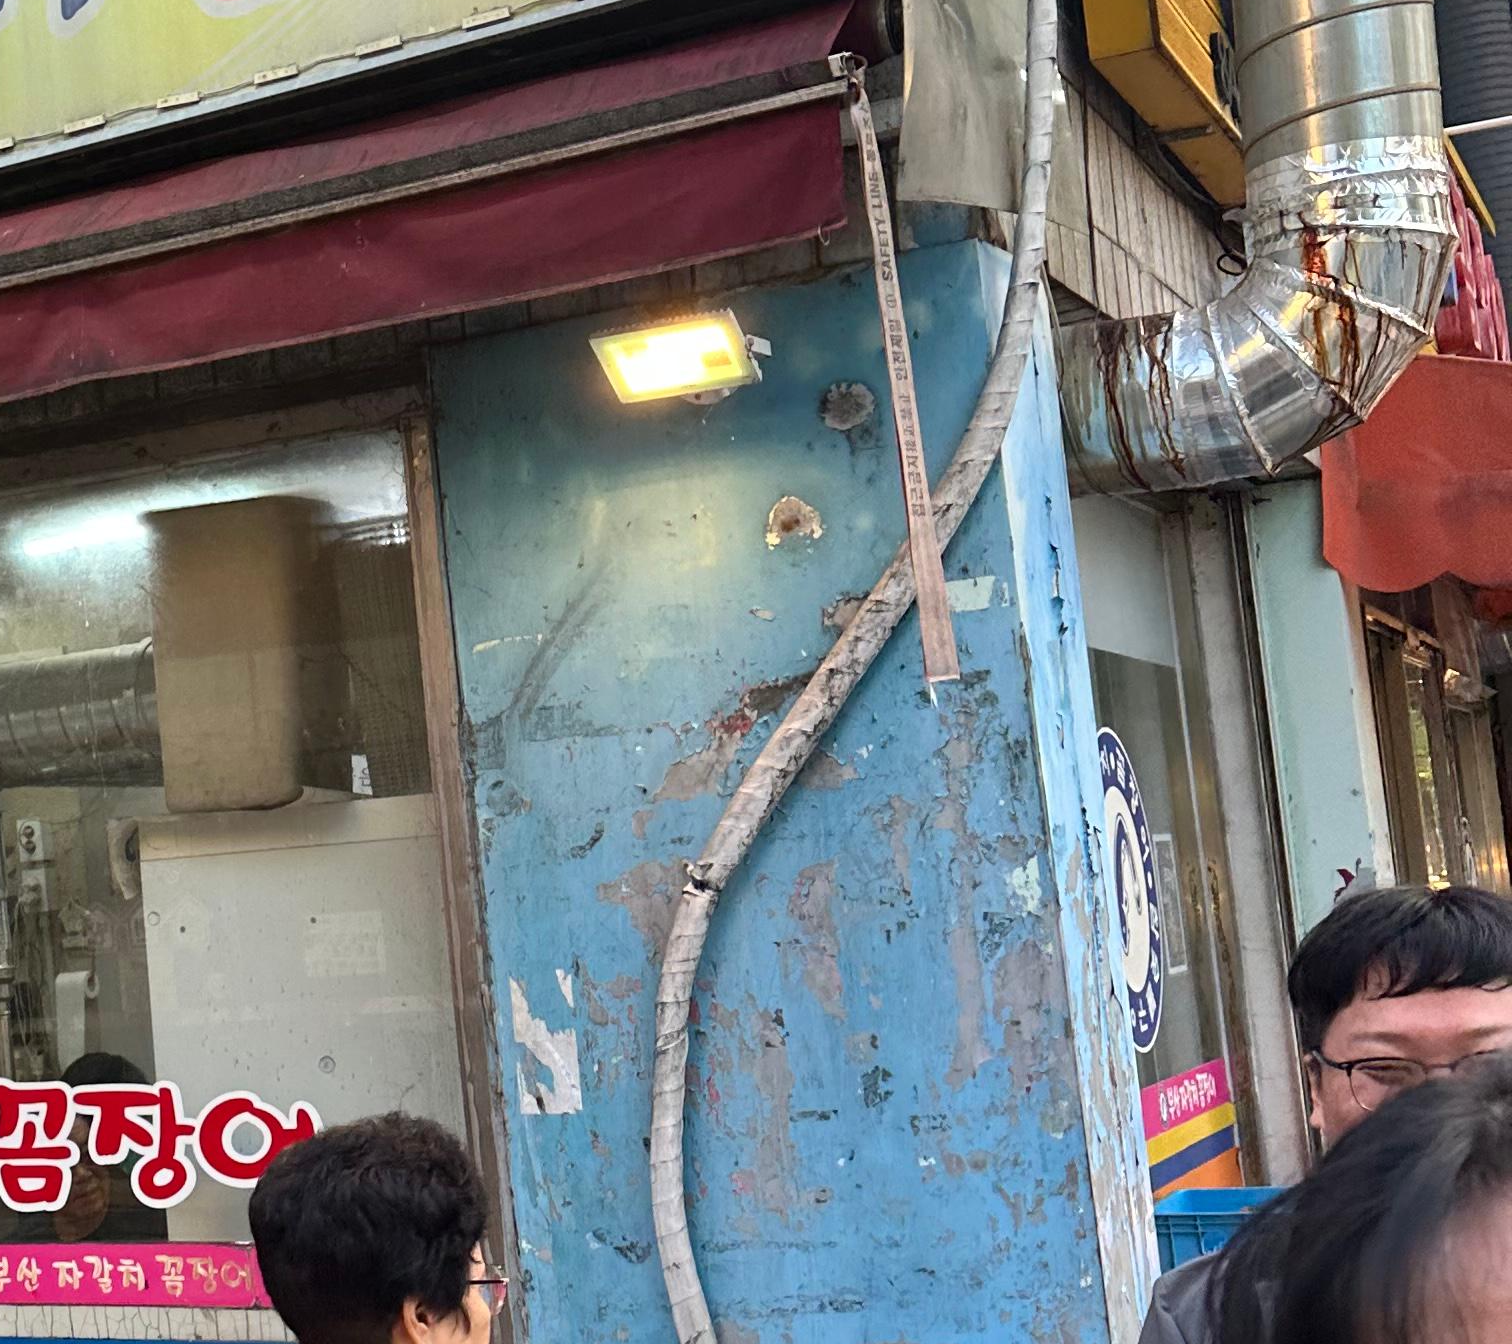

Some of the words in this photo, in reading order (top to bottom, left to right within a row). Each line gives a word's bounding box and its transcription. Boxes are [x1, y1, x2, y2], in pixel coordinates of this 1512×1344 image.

[874, 217, 894, 282] SAFETY
[52, 1256, 145, 1294] 자갈치
[155, 1254, 252, 1297] 꼼장어
